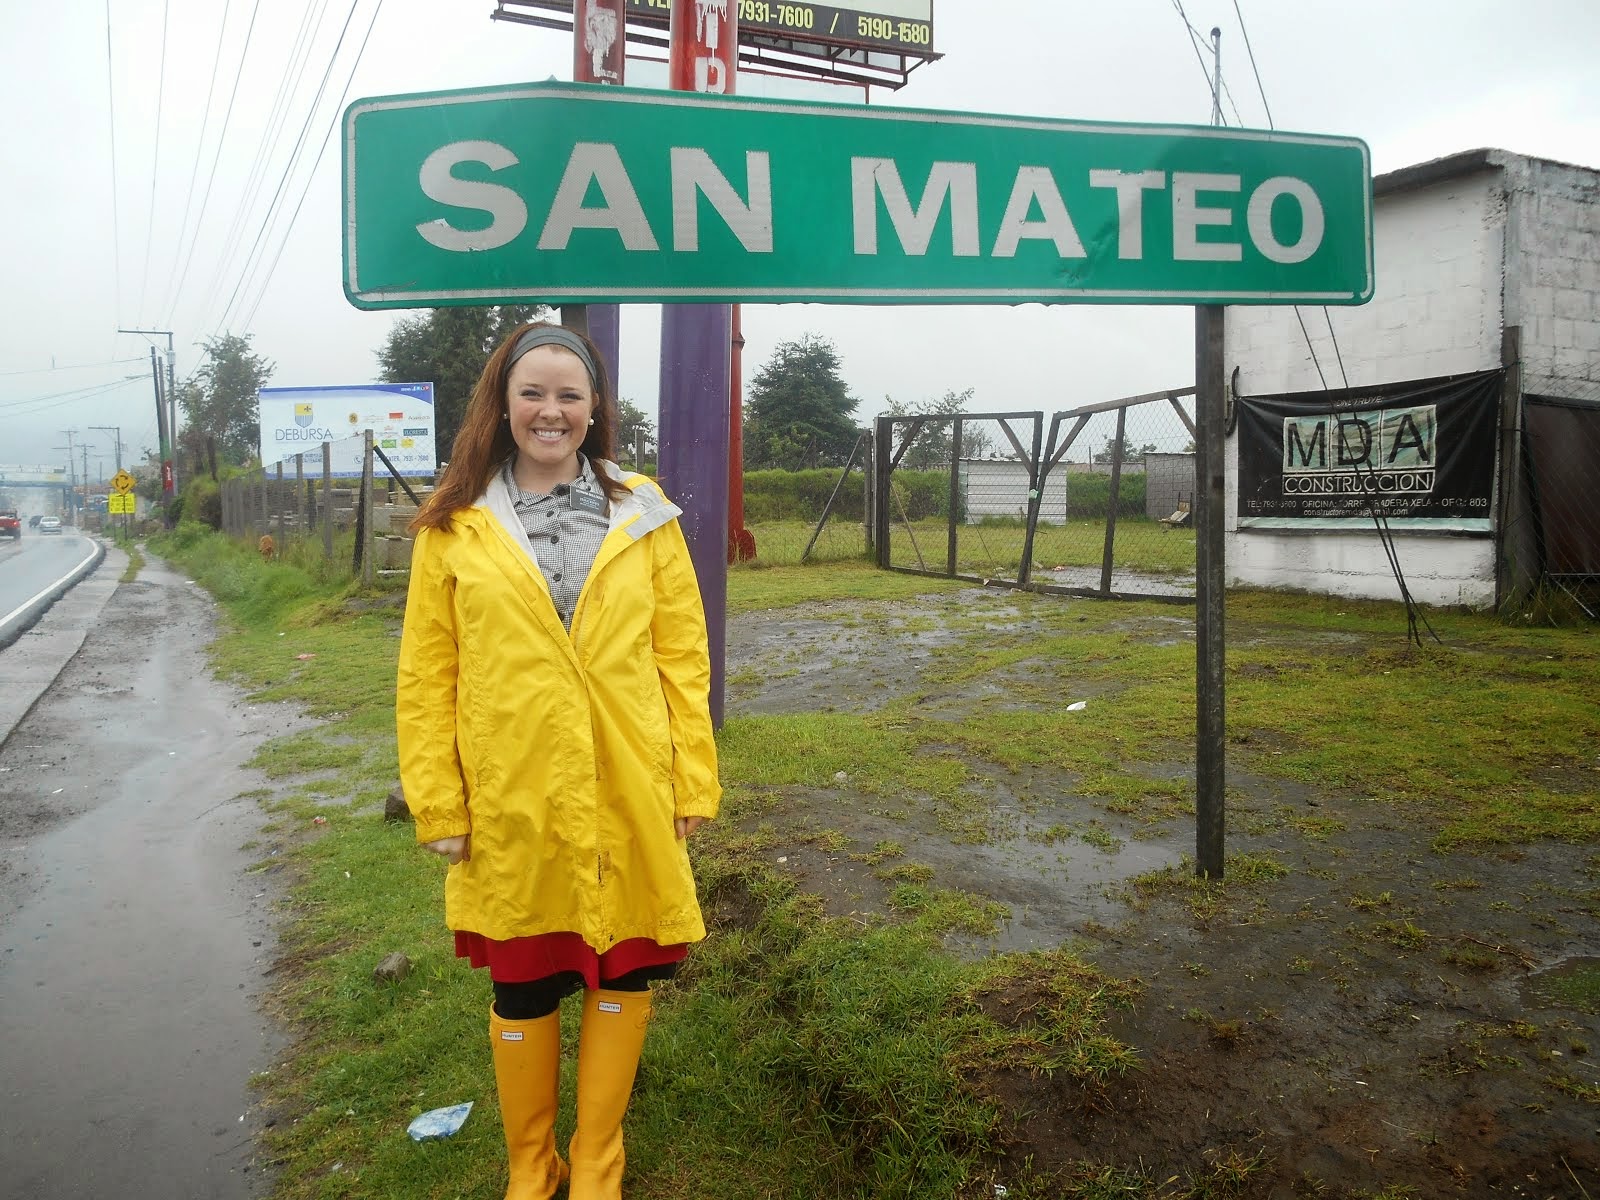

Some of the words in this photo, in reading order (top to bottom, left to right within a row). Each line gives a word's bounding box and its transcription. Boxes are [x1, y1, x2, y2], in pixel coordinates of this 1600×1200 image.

[858, 16, 930, 44] 5190-1580
[416, 141, 775, 252] SAN
[850, 156, 1326, 264] MATEO
[275, 428, 334, 440] DEBURSA
[1287, 413, 1430, 468] MDA
[1284, 474, 1430, 493] CONSTRUCCION
[1301, 499, 1337, 508] OFICINA:
[1469, 497, 1487, 507] 803
